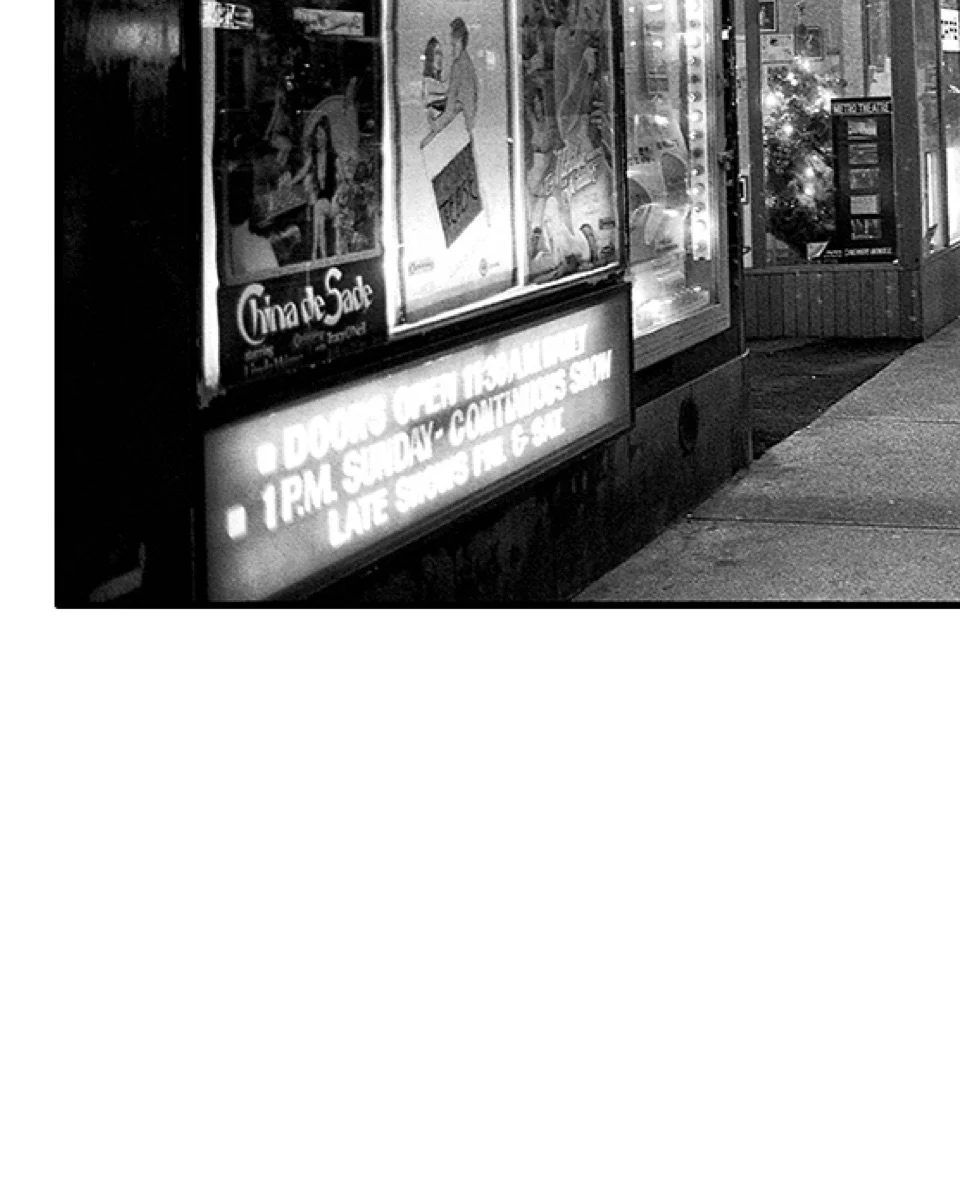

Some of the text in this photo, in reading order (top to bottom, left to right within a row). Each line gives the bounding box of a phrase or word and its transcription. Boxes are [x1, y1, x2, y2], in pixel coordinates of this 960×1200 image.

[236, 283, 299, 346] China
[301, 285, 326, 324] de
[323, 267, 373, 326] Sade
[262, 483, 278, 531] 1
[568, 349, 614, 394] SHOW
[282, 394, 388, 470] DOORS
[392, 371, 458, 426] OPEN
[326, 487, 389, 548] LATE
[394, 450, 469, 513] SHOWS
